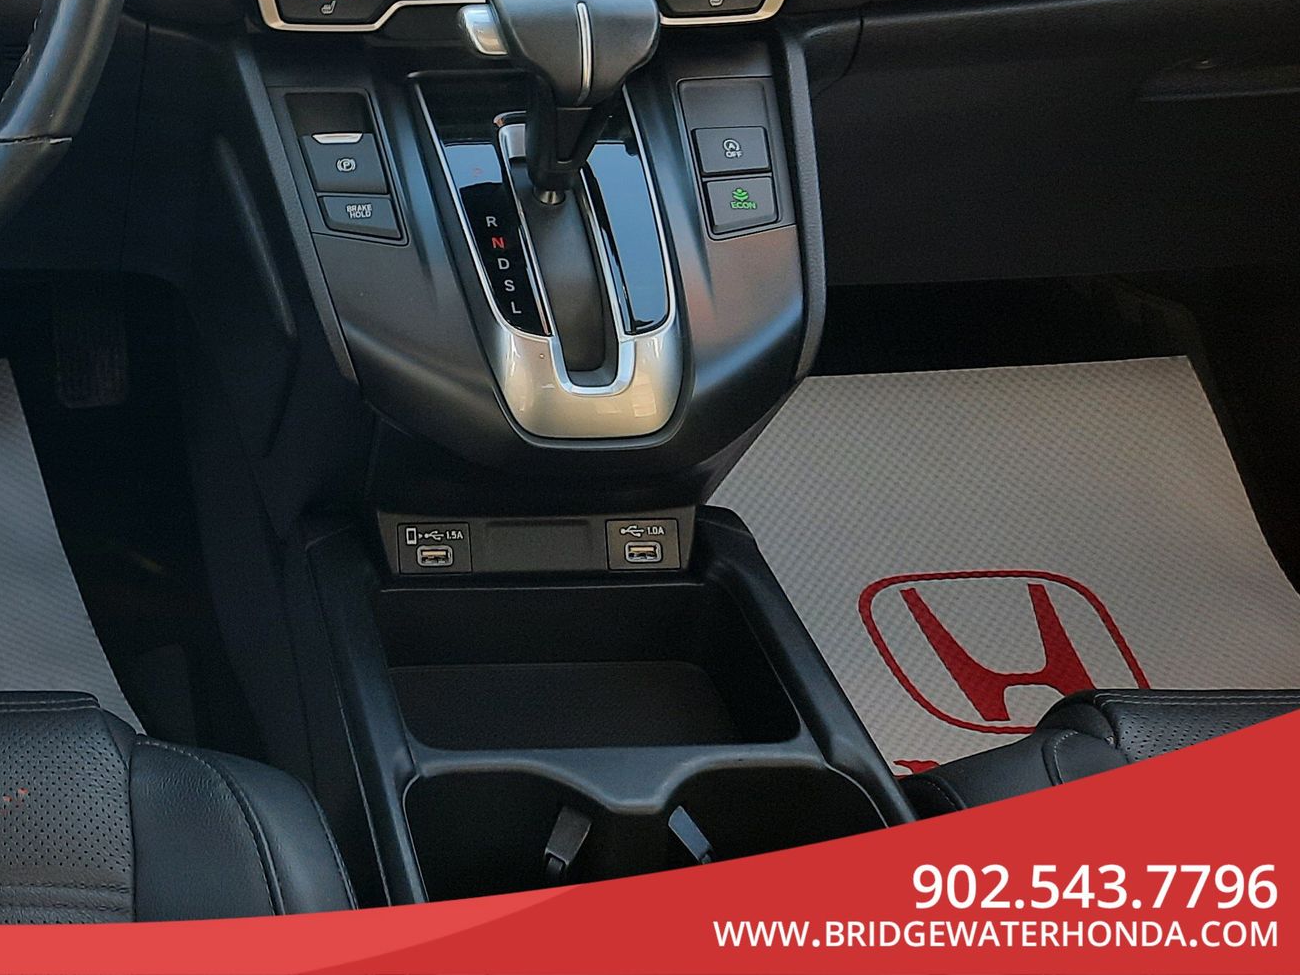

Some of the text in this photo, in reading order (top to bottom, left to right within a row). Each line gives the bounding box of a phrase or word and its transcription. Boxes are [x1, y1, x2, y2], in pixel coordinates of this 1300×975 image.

[725, 150, 743, 158] OFF
[346, 203, 372, 213] BRAKE
[730, 201, 756, 209] ECON
[350, 210, 372, 219] HOLD
[486, 216, 498, 227] R
[491, 237, 505, 248] N
[498, 258, 510, 270] D
[504, 279, 516, 292] S
[511, 301, 521, 314] L
[445, 530, 463, 540] 1.5A
[646, 525, 665, 536] 1.0A
